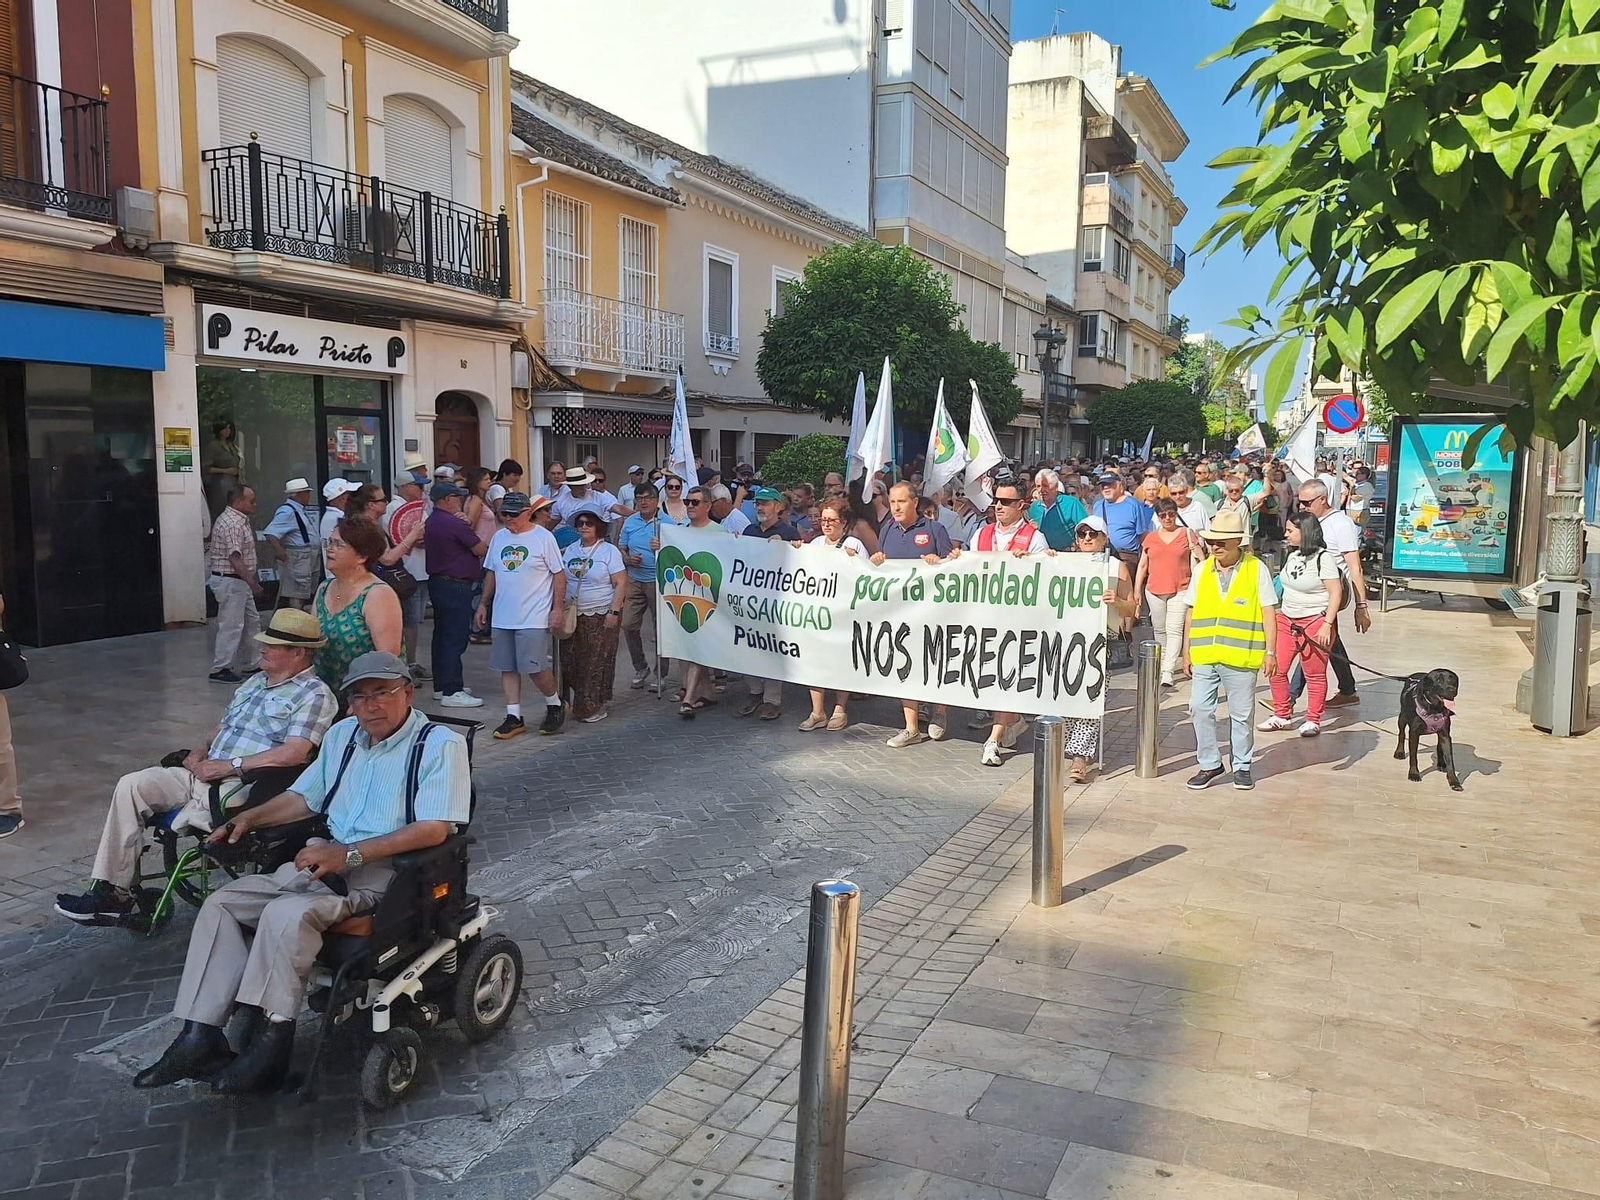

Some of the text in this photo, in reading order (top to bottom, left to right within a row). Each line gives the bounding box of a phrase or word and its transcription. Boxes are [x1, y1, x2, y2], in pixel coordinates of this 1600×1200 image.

[244, 327, 299, 356] Pilar
[319, 336, 372, 364] Prieto
[1437, 460, 1460, 468] DOB
[729, 558, 838, 598] PuenteGenil
[850, 561, 1104, 619] por la sanidad que
[727, 593, 832, 630] por su SANIDAD
[734, 625, 801, 658] Pública
[851, 620, 1107, 703] NOS MERECEMOS
